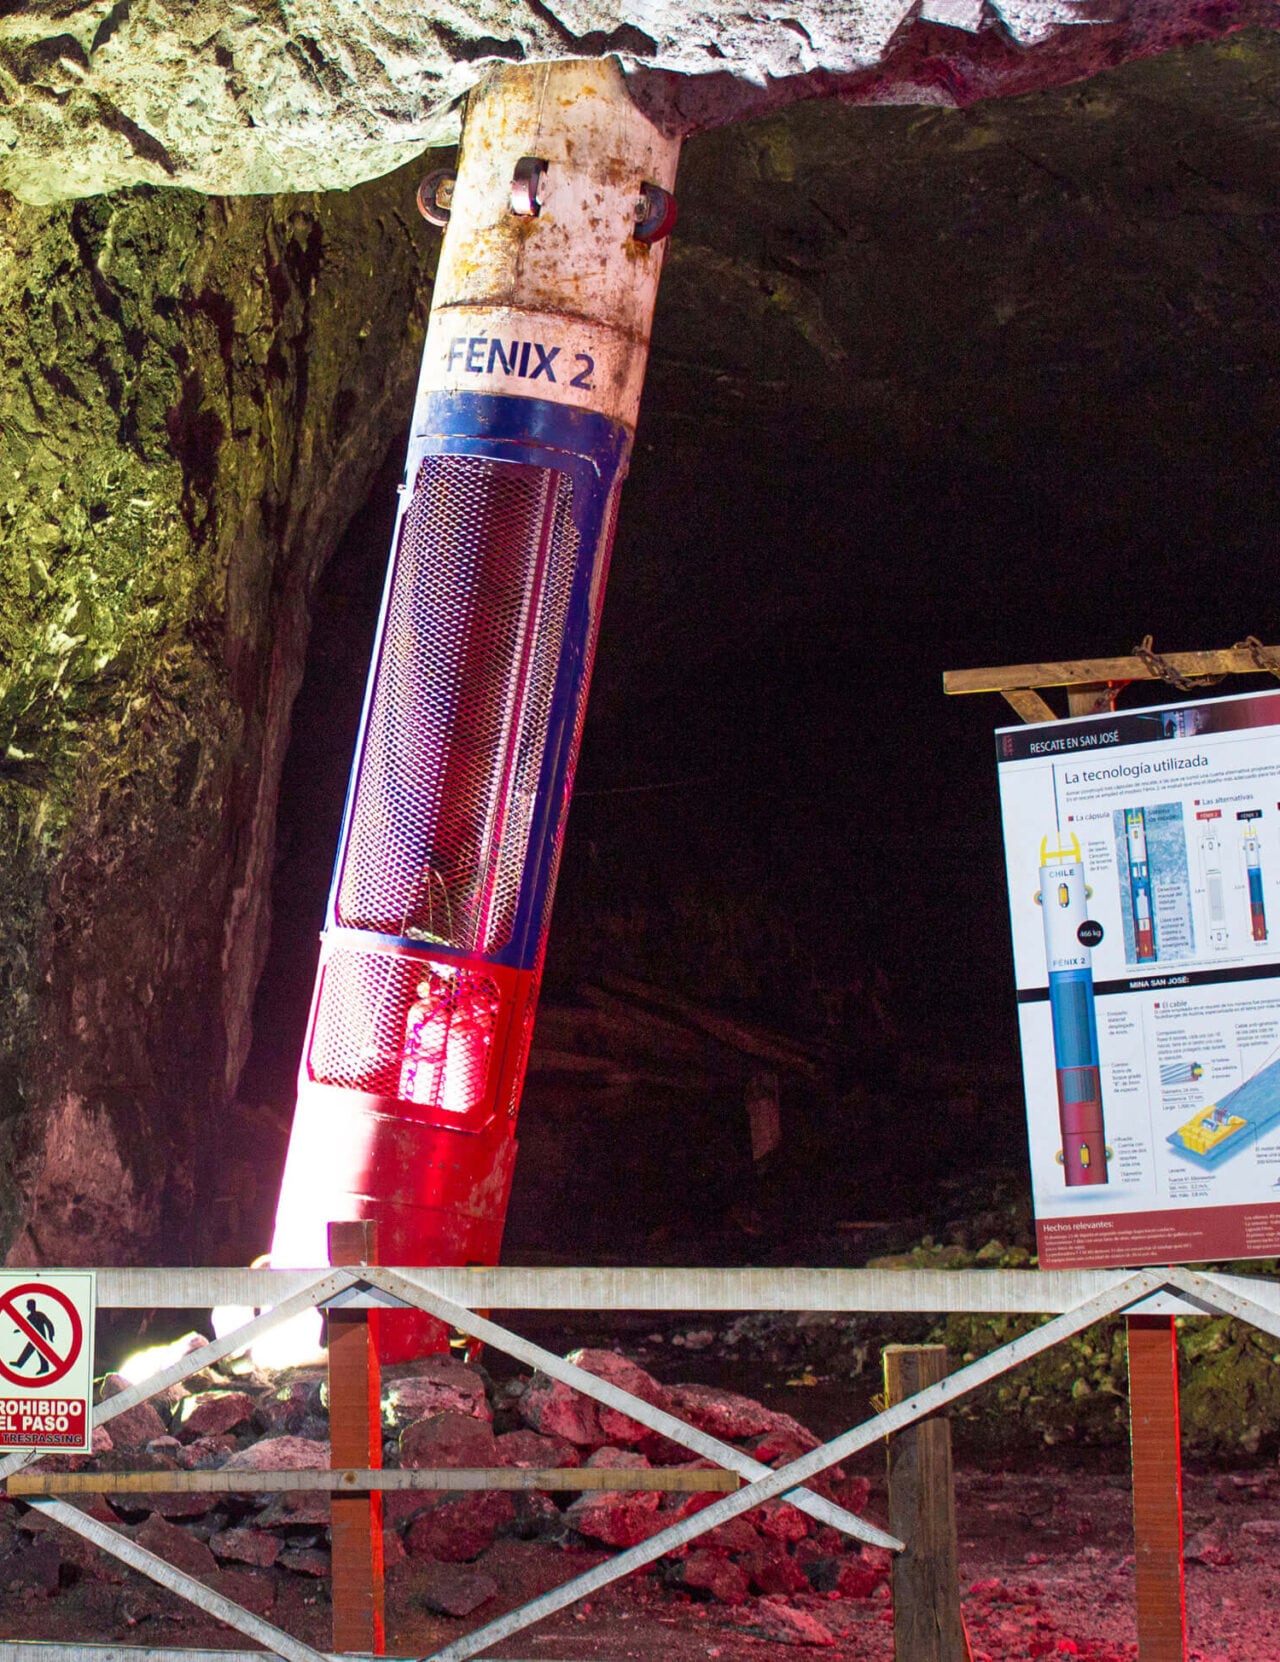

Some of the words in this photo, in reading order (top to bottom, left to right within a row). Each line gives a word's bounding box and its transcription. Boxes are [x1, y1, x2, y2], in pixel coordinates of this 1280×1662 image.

[446, 329, 561, 383] FÉNIX
[569, 353, 596, 390] 2
[1030, 739, 1065, 754] RESCATE
[1066, 737, 1079, 749] EN
[1079, 734, 1098, 747] SAN
[1098, 729, 1120, 745] JOSÉ
[1064, 772, 1080, 784] La
[1083, 762, 1151, 783] tecnología
[1153, 754, 1209, 773] utilizada
[1202, 797, 1214, 806] Las
[1215, 793, 1254, 804] alternativas
[1076, 814, 1084, 822] La
[1085, 810, 1110, 822] cápsula
[1049, 868, 1076, 878] CHILE
[1080, 957, 1086, 966] 2
[1130, 980, 1150, 989] MINA
[1151, 978, 1166, 988] SAN
[1169, 1000, 1187, 1008] cable
[1043, 1223, 1071, 1232] Hechos
[1073, 1220, 1114, 1230] relevantes:
[22, 1416, 69, 1431] PASO
[2, 1433, 83, 1444] TRESPASSING
